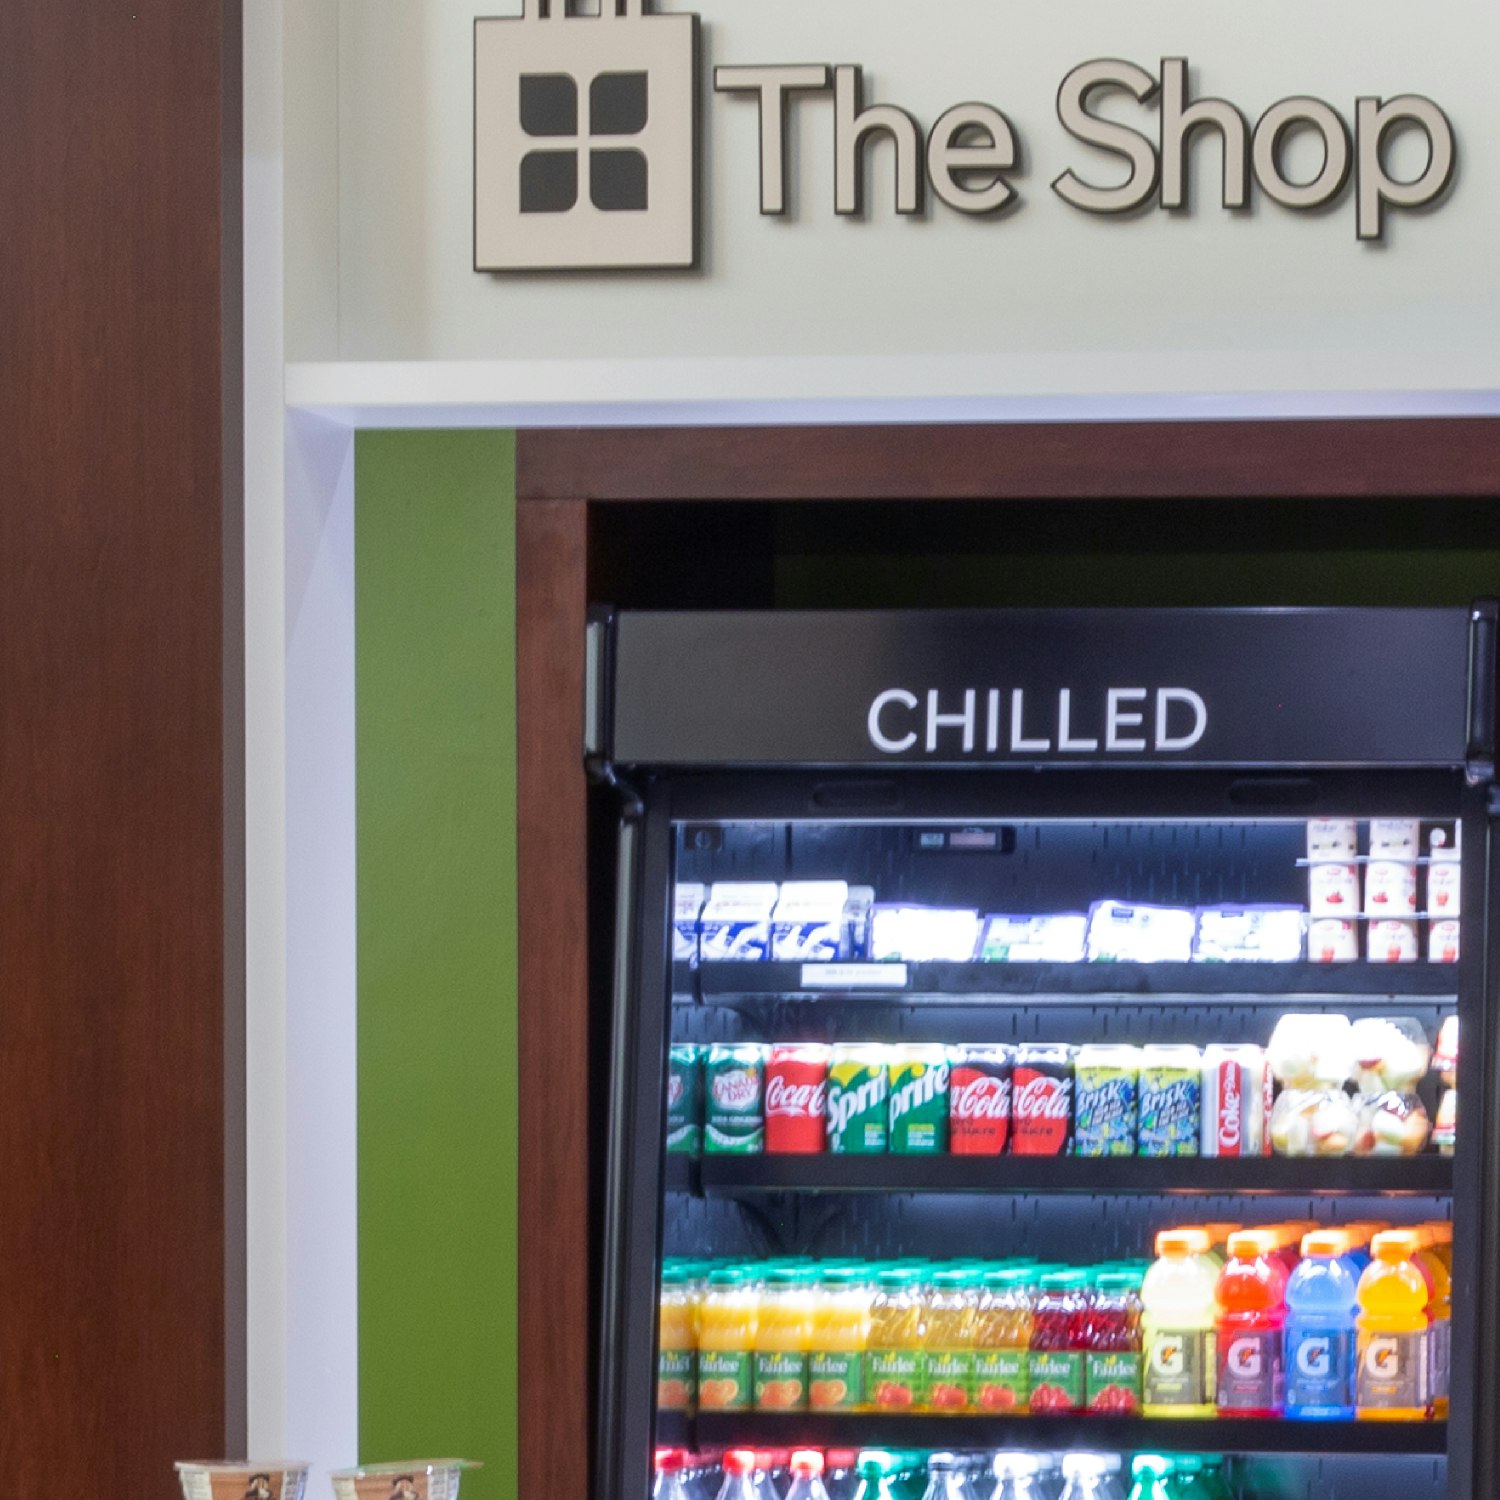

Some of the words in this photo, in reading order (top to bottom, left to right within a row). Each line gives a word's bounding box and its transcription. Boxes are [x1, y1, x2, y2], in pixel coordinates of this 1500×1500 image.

[713, 65, 1019, 216] The
[1050, 57, 1456, 241] Shop
[866, 686, 1208, 754] CHILLED
[889, 1064, 949, 1132] prite
[1152, 1336, 1184, 1375] G
[1227, 1337, 1261, 1377] G
[1296, 1337, 1331, 1376] G
[1365, 1337, 1398, 1378] G
